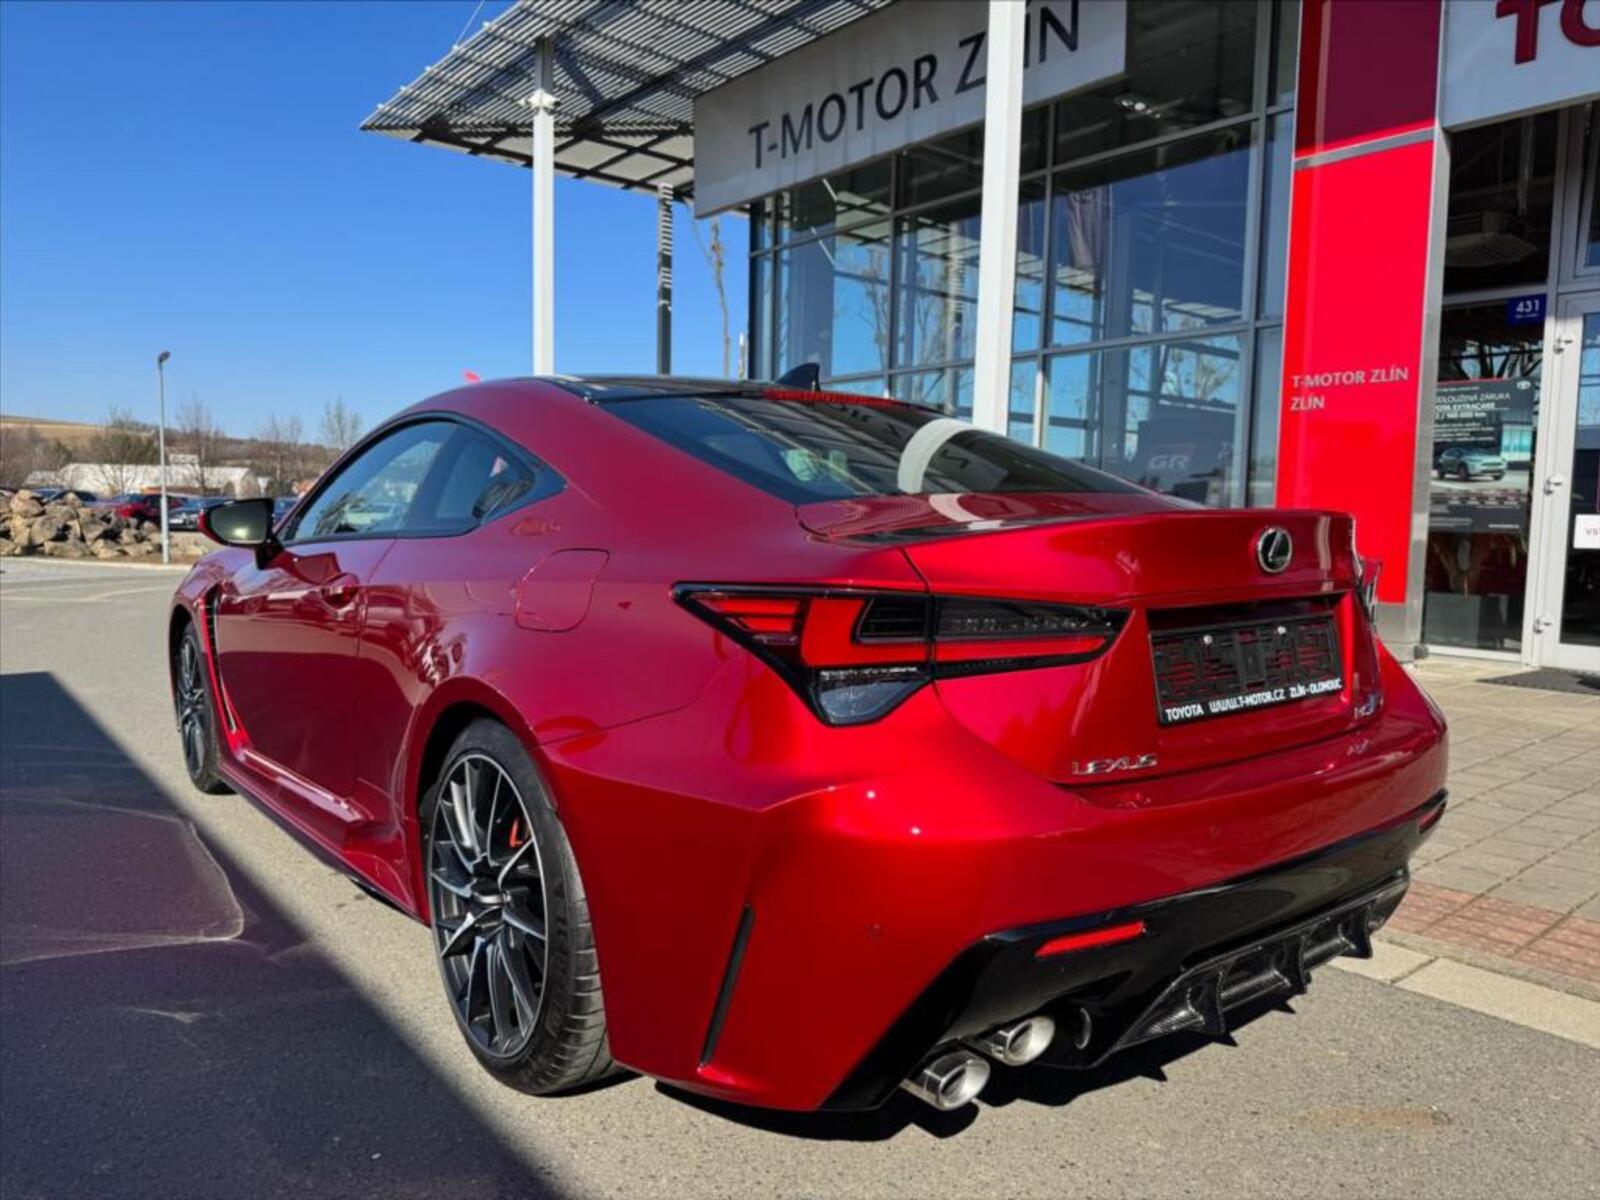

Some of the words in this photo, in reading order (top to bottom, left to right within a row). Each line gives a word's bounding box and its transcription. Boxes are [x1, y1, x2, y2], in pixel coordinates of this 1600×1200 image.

[748, 54, 939, 168] T-MOTOR
[954, 0, 1079, 94] ZÍN
[1516, 299, 1540, 312] 431
[1291, 370, 1366, 388] T-MOTOR
[1369, 364, 1409, 384] ZLÍN
[1289, 393, 1325, 411] ZLÍN
[1165, 703, 1205, 722] TOYOTA
[1071, 753, 1158, 775] LEXUS
